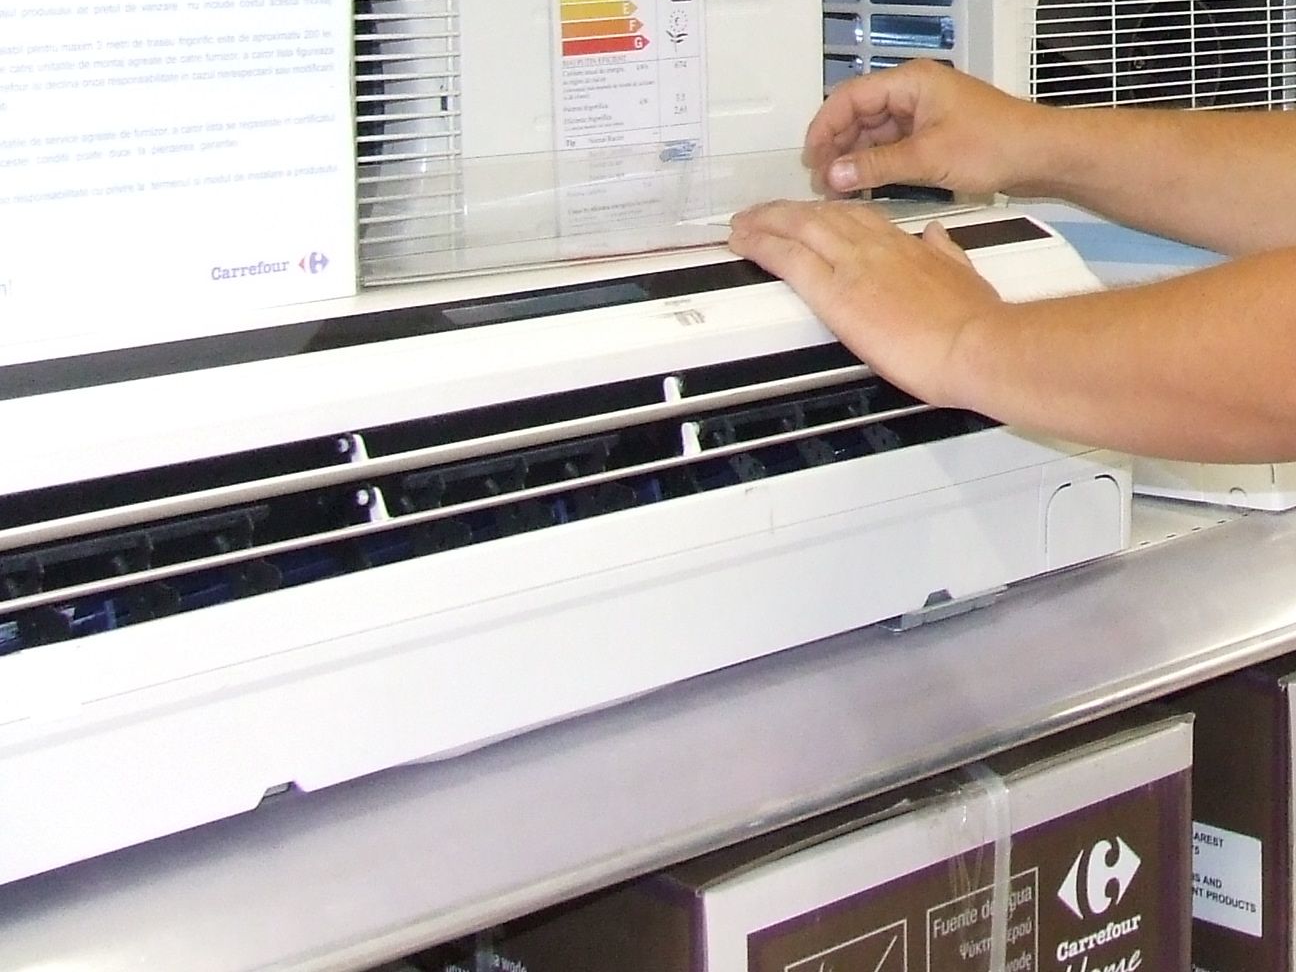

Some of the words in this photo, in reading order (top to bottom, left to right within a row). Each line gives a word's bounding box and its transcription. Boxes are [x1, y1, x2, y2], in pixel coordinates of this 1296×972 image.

[628, 19, 636, 31] F
[634, 36, 643, 49] G
[211, 258, 290, 281] Carrefour
[1193, 832, 1224, 849] AREST
[1203, 877, 1223, 889] AND
[1206, 890, 1257, 913] PRODUCTS
[933, 907, 979, 939] Fuente
[1056, 914, 1142, 962] Carrefour
